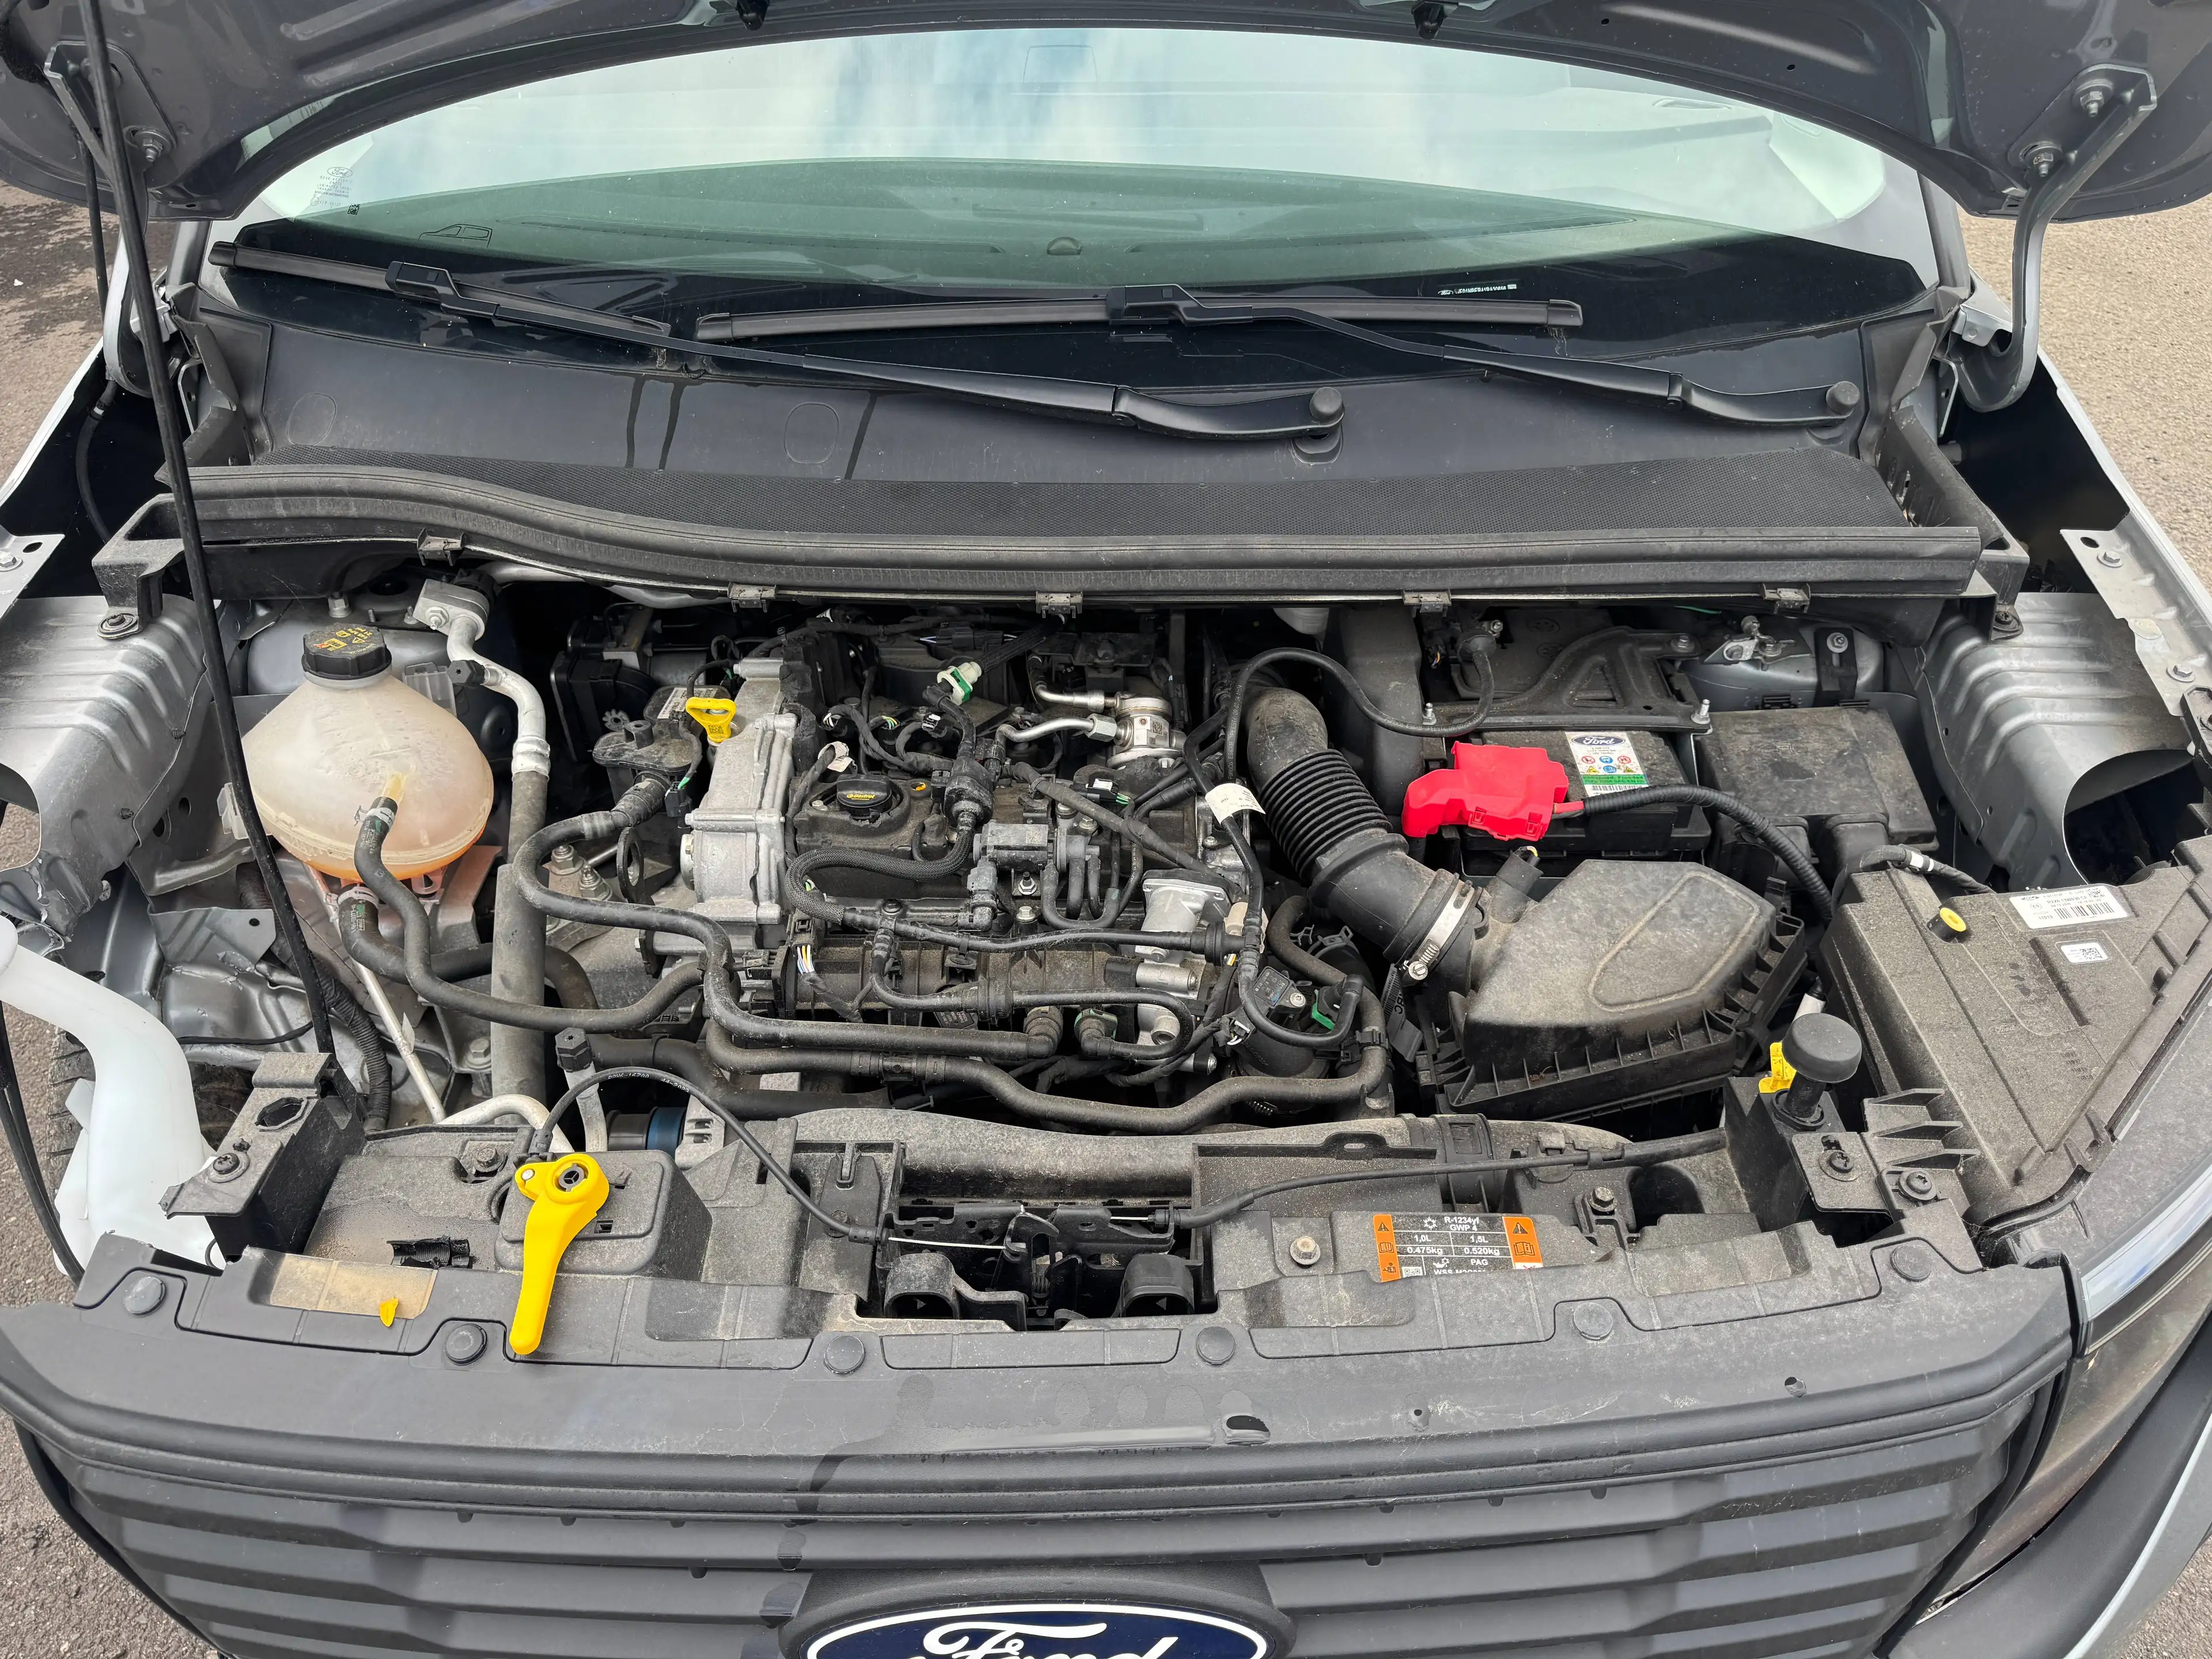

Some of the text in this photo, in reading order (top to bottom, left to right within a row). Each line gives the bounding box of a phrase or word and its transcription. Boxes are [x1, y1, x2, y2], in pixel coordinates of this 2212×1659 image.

[1583, 736, 1615, 745] Ford
[1444, 1217, 1480, 1225] R-1234yf
[1414, 1234, 1432, 1243] 1,0L
[1407, 1247, 1500, 1256] 0.475kg 0.520kg
[923, 1621, 1179, 1659] Fd
